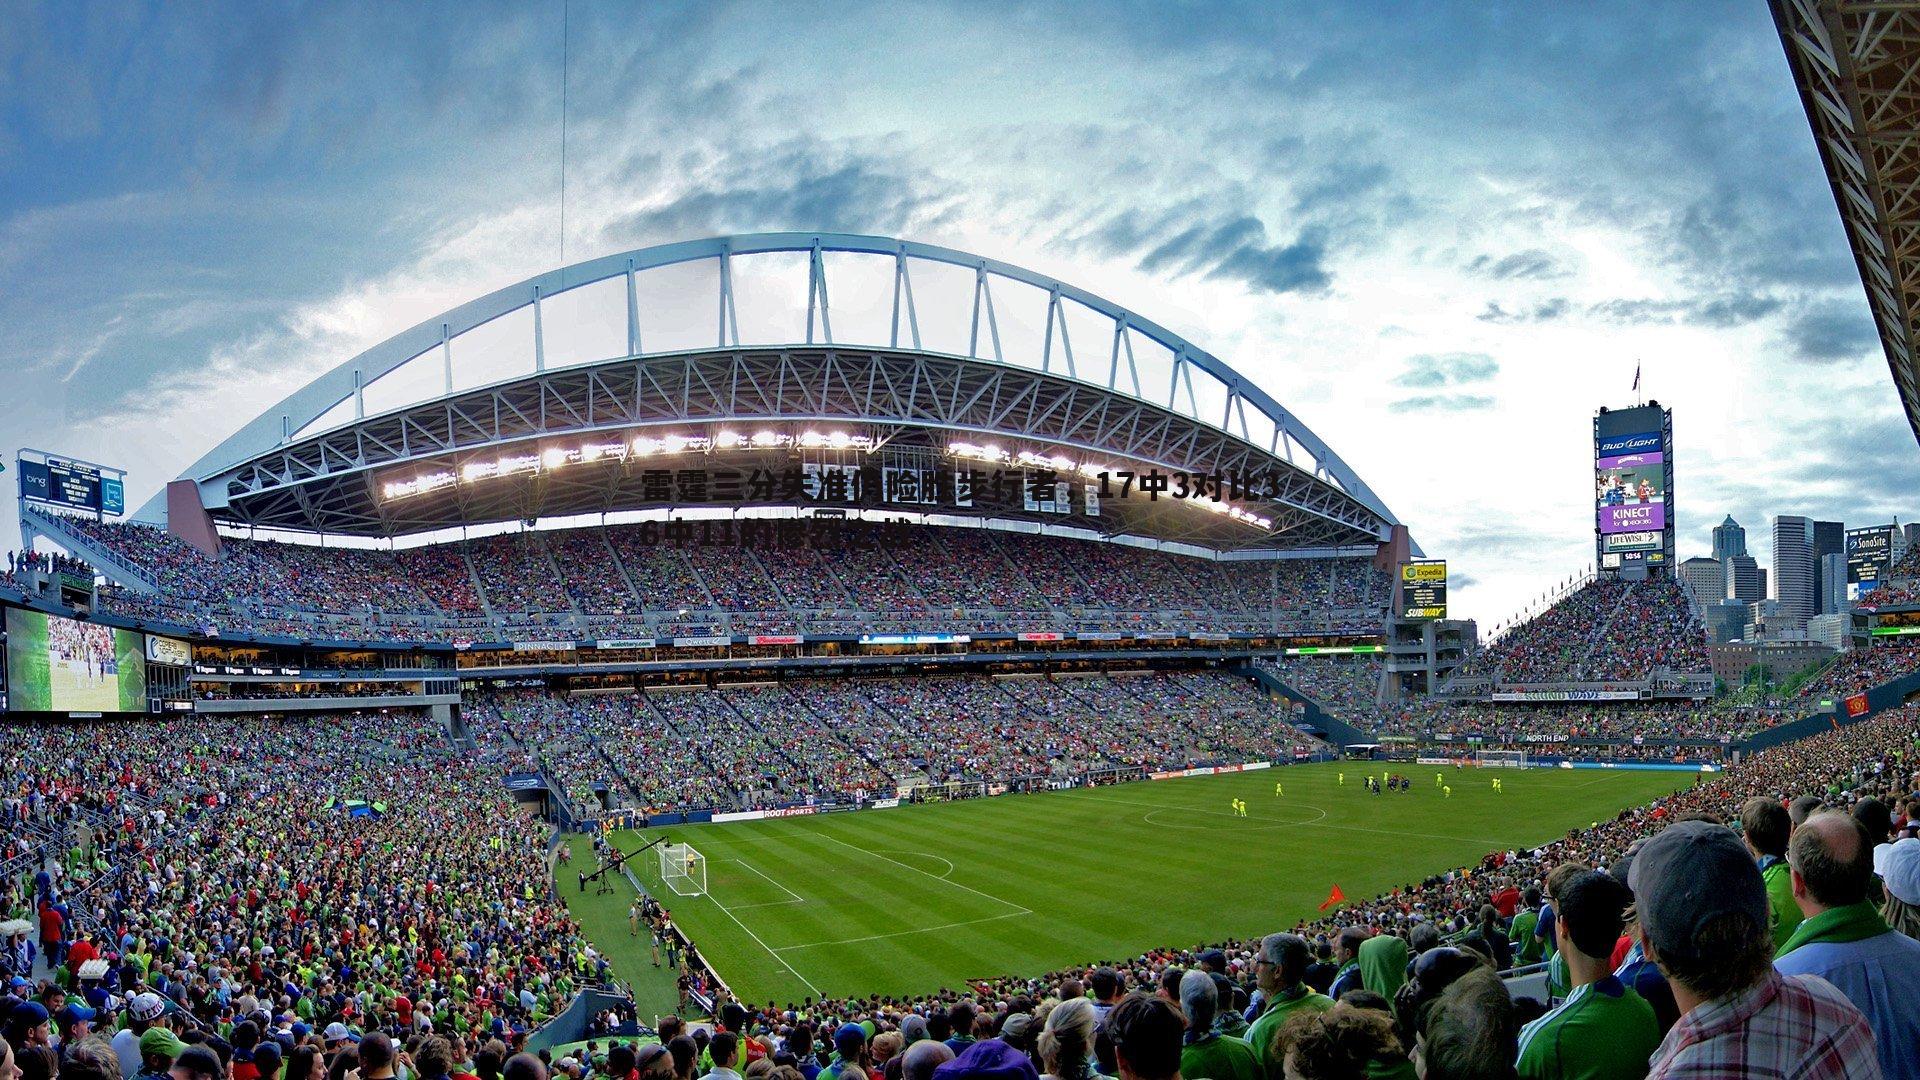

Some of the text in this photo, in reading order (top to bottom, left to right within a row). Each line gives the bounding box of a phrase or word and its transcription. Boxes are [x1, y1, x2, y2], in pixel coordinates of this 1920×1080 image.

[1602, 438, 1658, 451] BUD LIGHT
[26, 474, 46, 487] bing
[1613, 507, 1653, 519] KINECT
[1858, 536, 1886, 548] SonoSite
[1417, 568, 1442, 577] Expedia
[1405, 608, 1444, 618] SUBWAY
[518, 642, 564, 650] PINNACLE
[765, 808, 786, 818] ROOT
[786, 808, 813, 816] SPORTS
